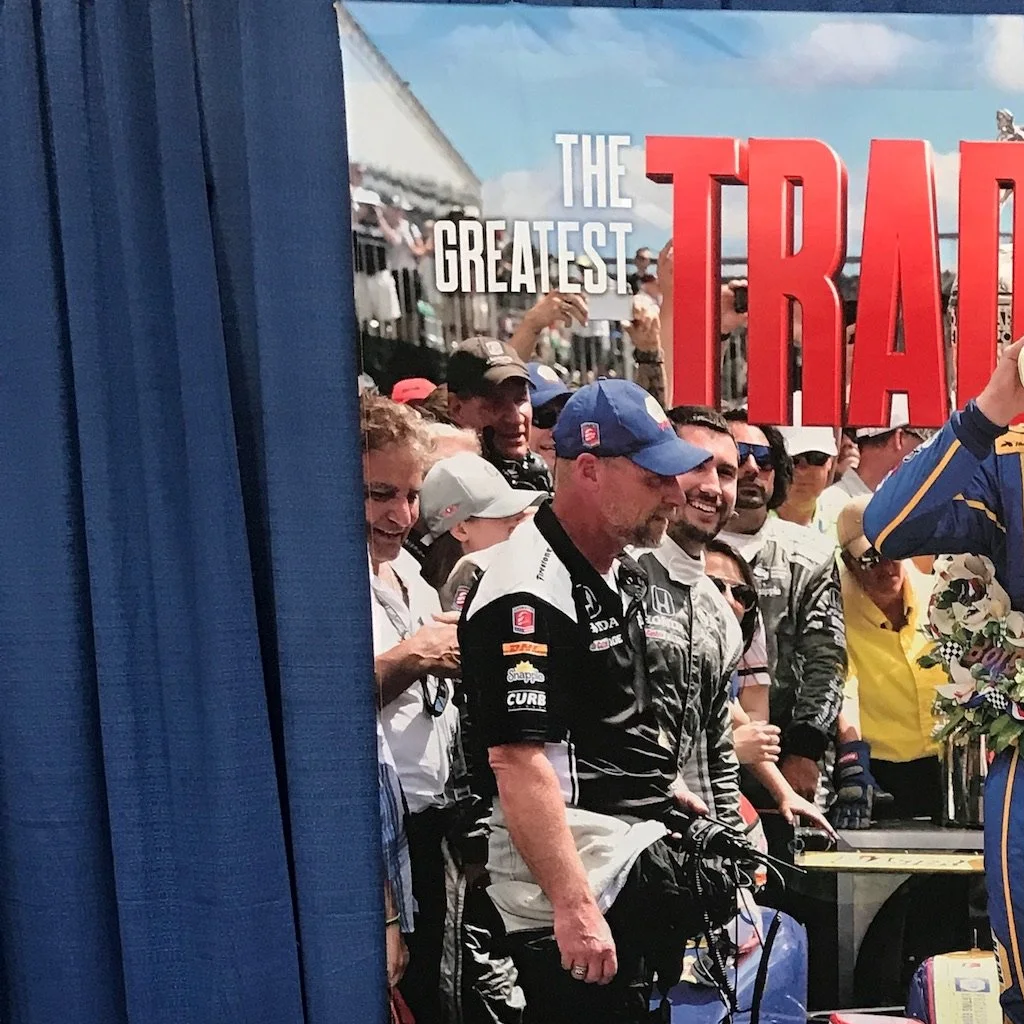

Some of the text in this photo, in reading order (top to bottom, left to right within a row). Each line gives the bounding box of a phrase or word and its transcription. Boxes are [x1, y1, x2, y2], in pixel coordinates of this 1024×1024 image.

[555, 133, 632, 209] THE
[433, 219, 634, 295] GREATEST
[507, 692, 547, 707] CURB
